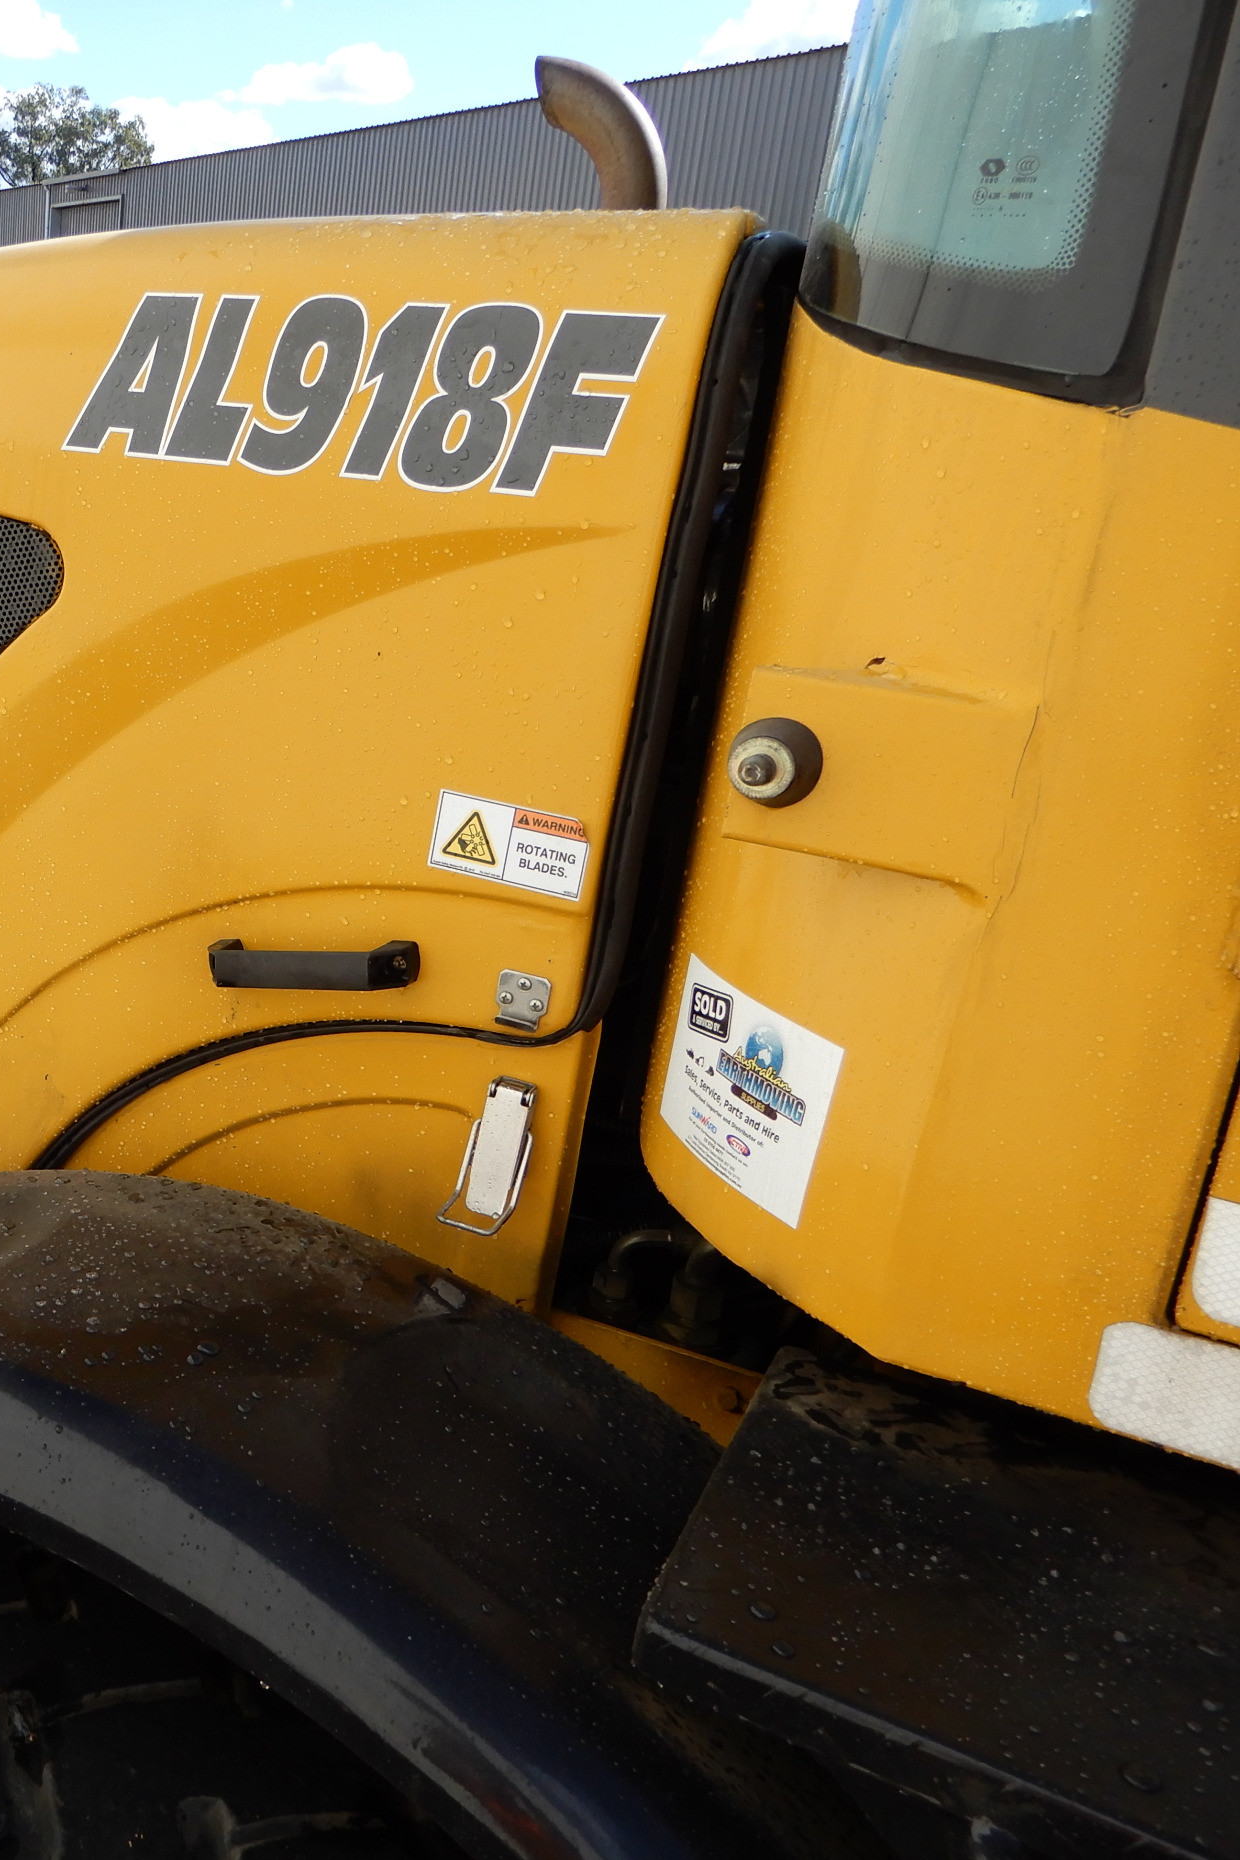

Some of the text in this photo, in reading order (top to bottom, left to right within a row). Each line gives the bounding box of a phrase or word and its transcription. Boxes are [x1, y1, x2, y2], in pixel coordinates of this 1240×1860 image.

[61, 293, 666, 497] AL918F
[516, 842, 576, 865] ROTATING
[518, 857, 567, 879] BLADES.
[693, 991, 727, 1020] SOLD
[718, 1053, 804, 1124] EARTHMOVING
[733, 1046, 792, 1092] Australian
[700, 1080, 722, 1106] Service,
[723, 1100, 744, 1120] Parts
[744, 1115, 761, 1131] and
[761, 1125, 780, 1143] Hire
